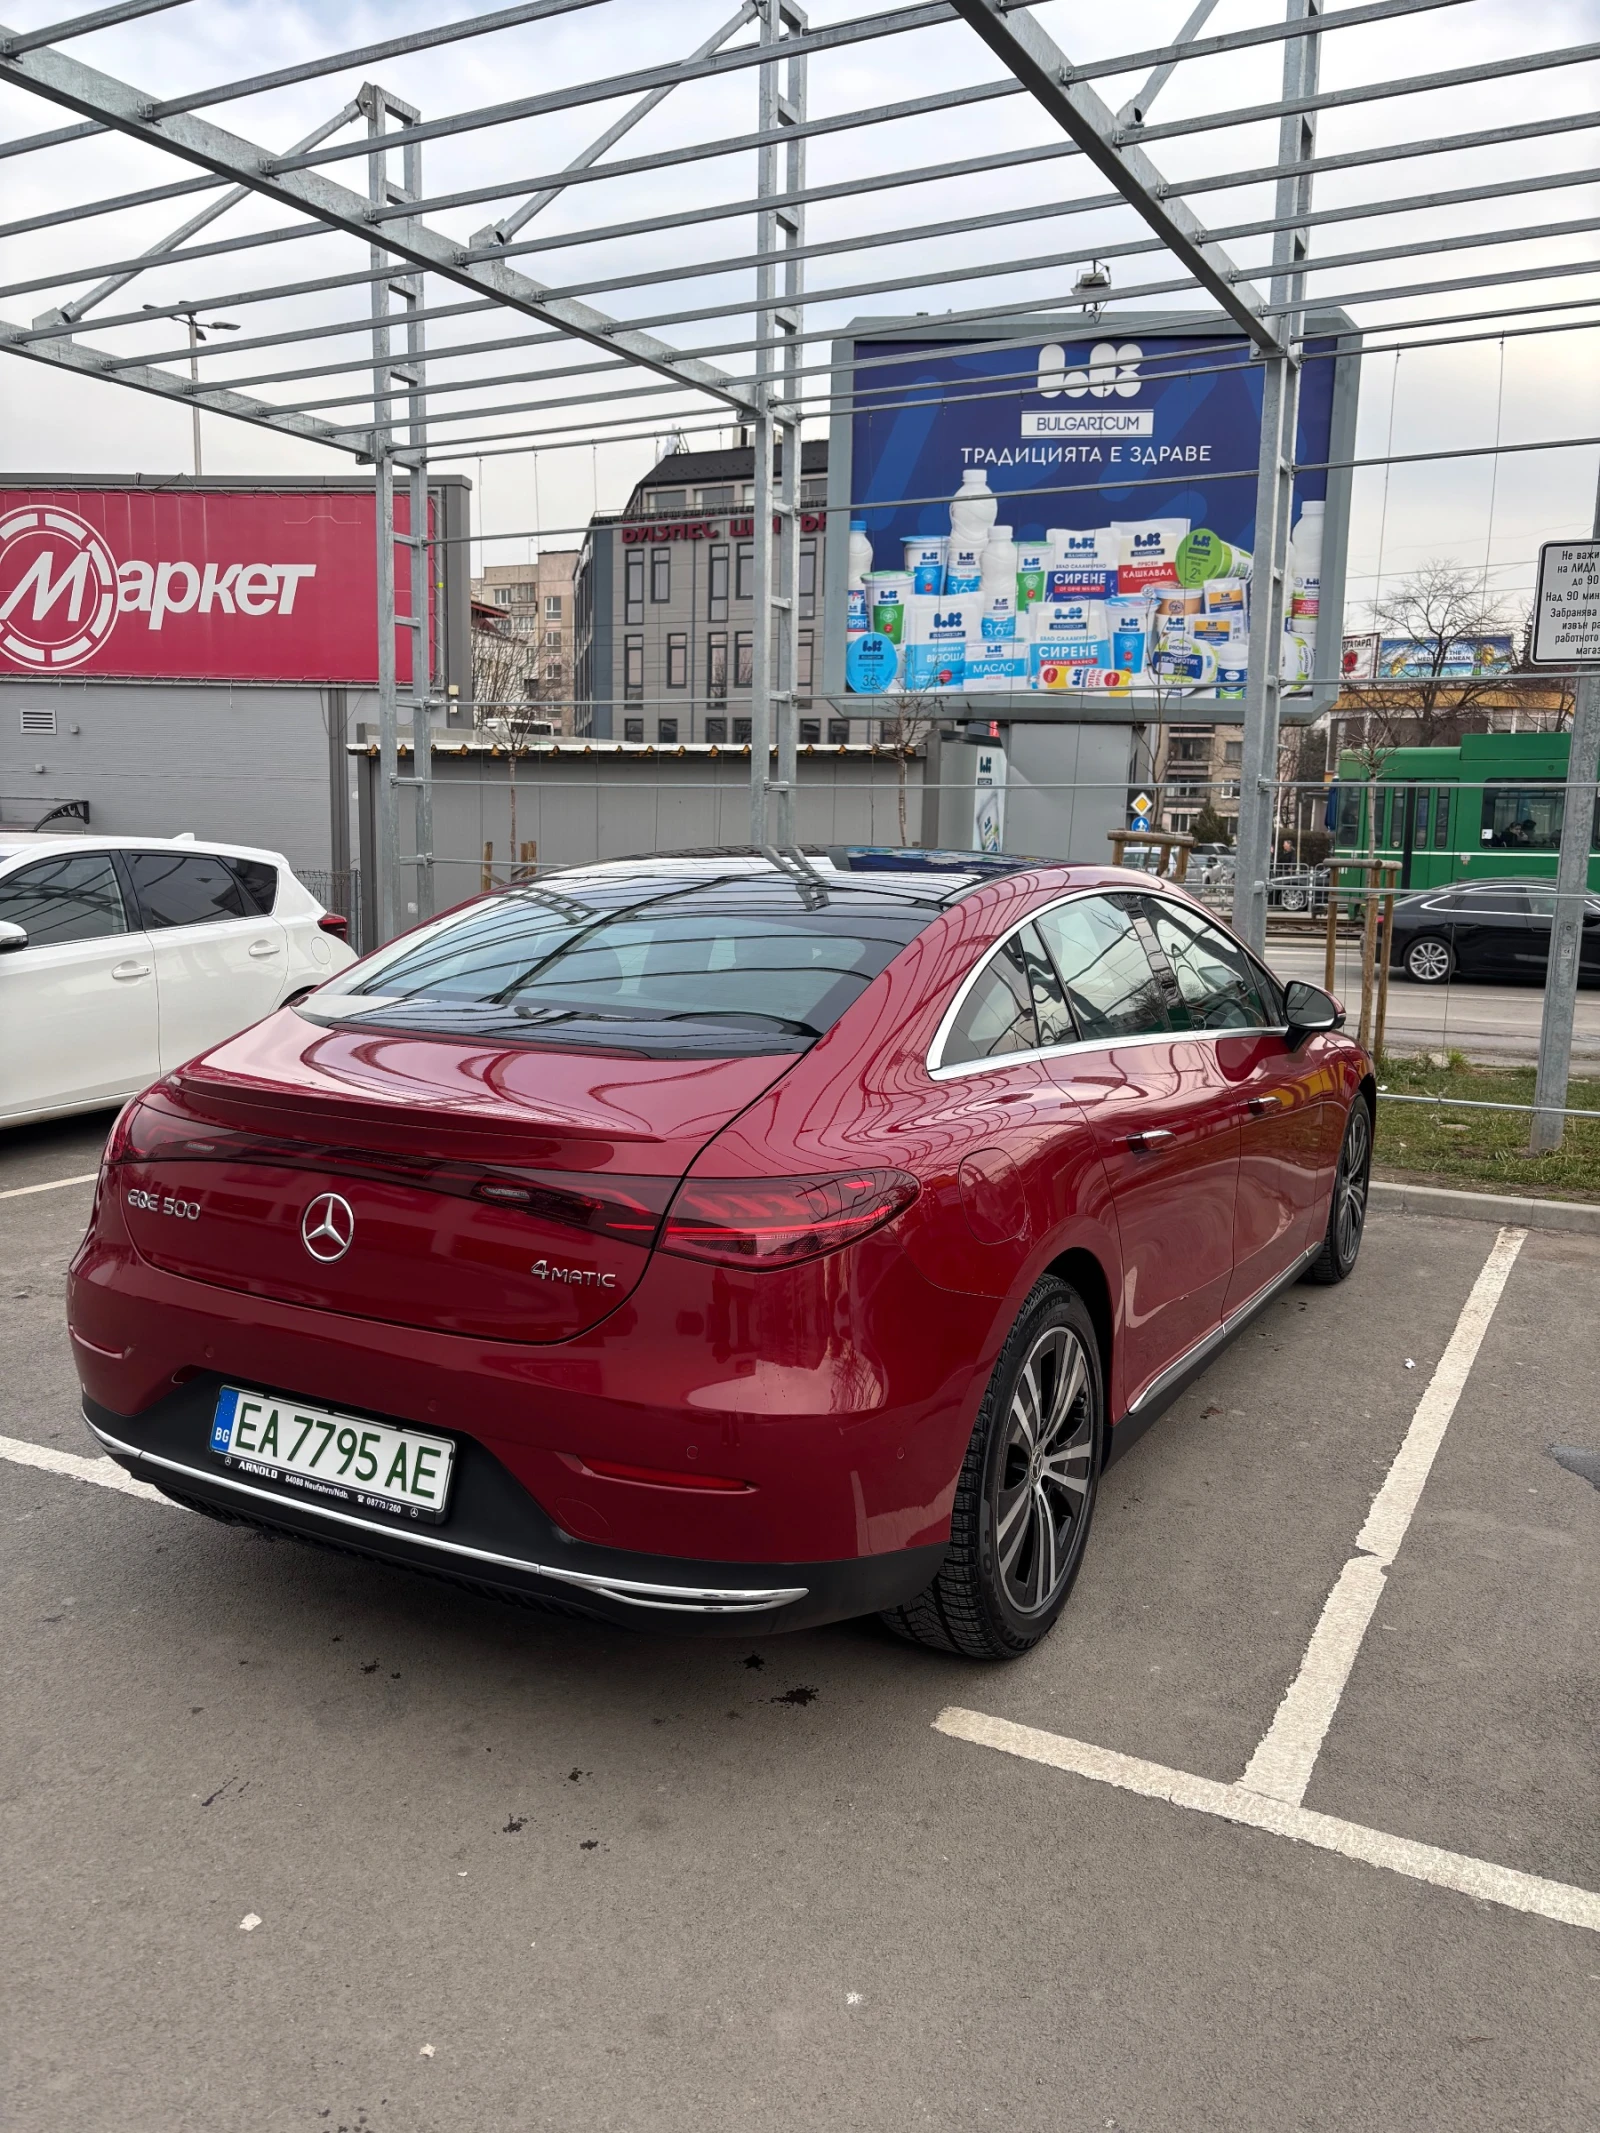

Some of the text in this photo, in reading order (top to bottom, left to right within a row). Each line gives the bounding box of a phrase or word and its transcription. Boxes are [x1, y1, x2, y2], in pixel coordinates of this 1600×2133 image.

[1036, 416, 1139, 432] BULGARICUM
[961, 446, 1212, 467] ТРАДИЦИЯТА Е ЗДРАВЕ
[1562, 550, 1573, 560] Не
[1123, 569, 1173, 578] КАШКАВАЛ
[1557, 562, 1596, 574] на ЛИДЛ
[1054, 572, 1106, 585] СИРЕНЕ
[1572, 575, 1599, 586] до 90
[0, 551, 317, 630] Маркет
[1545, 592, 1563, 602] Над
[1566, 591, 1579, 601] 90
[1550, 608, 1597, 620] Забранява
[1562, 621, 1588, 630] извън
[1555, 632, 1599, 645] работното
[1038, 645, 1098, 658] СИРЕНЕ
[1161, 655, 1199, 665] ПРОБИОТИК
[973, 663, 1015, 673] МАСЛО
[128, 1189, 200, 1220] EQE 500
[531, 1260, 616, 1288] 4MATIC
[214, 1427, 230, 1443] BG
[287, 1415, 381, 1482] 7795
[238, 1460, 278, 1479] ARNOLD
